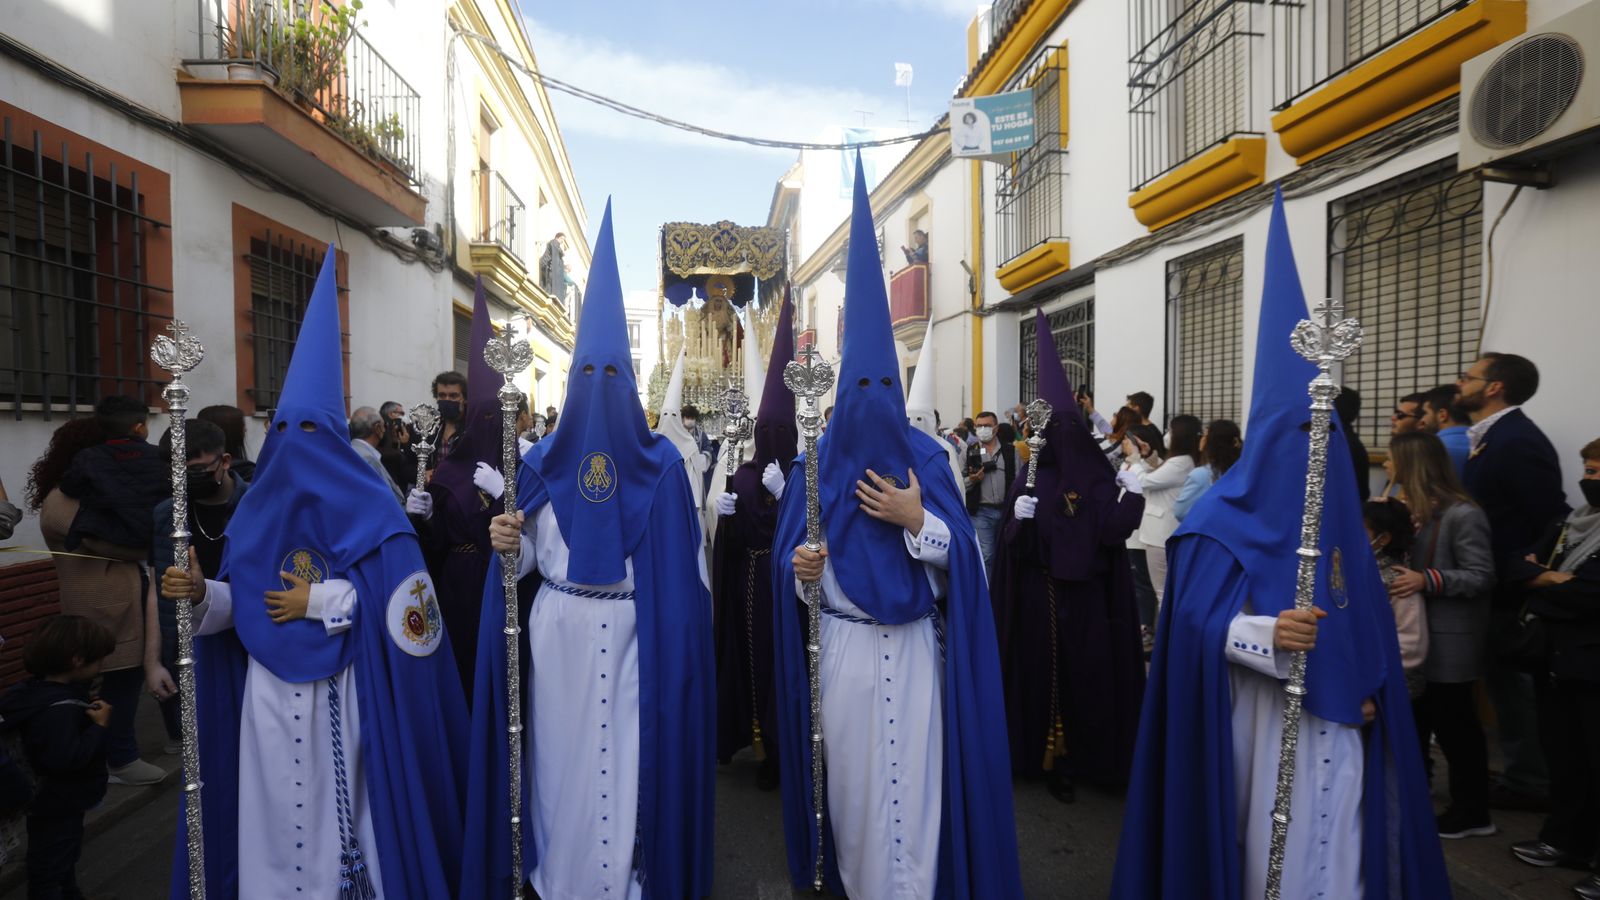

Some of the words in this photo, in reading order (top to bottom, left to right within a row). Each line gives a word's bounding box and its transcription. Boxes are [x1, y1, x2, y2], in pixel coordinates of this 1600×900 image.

[995, 114, 1016, 123] ESTE
[1017, 111, 1028, 120] ES
[991, 123, 1003, 131] TU
